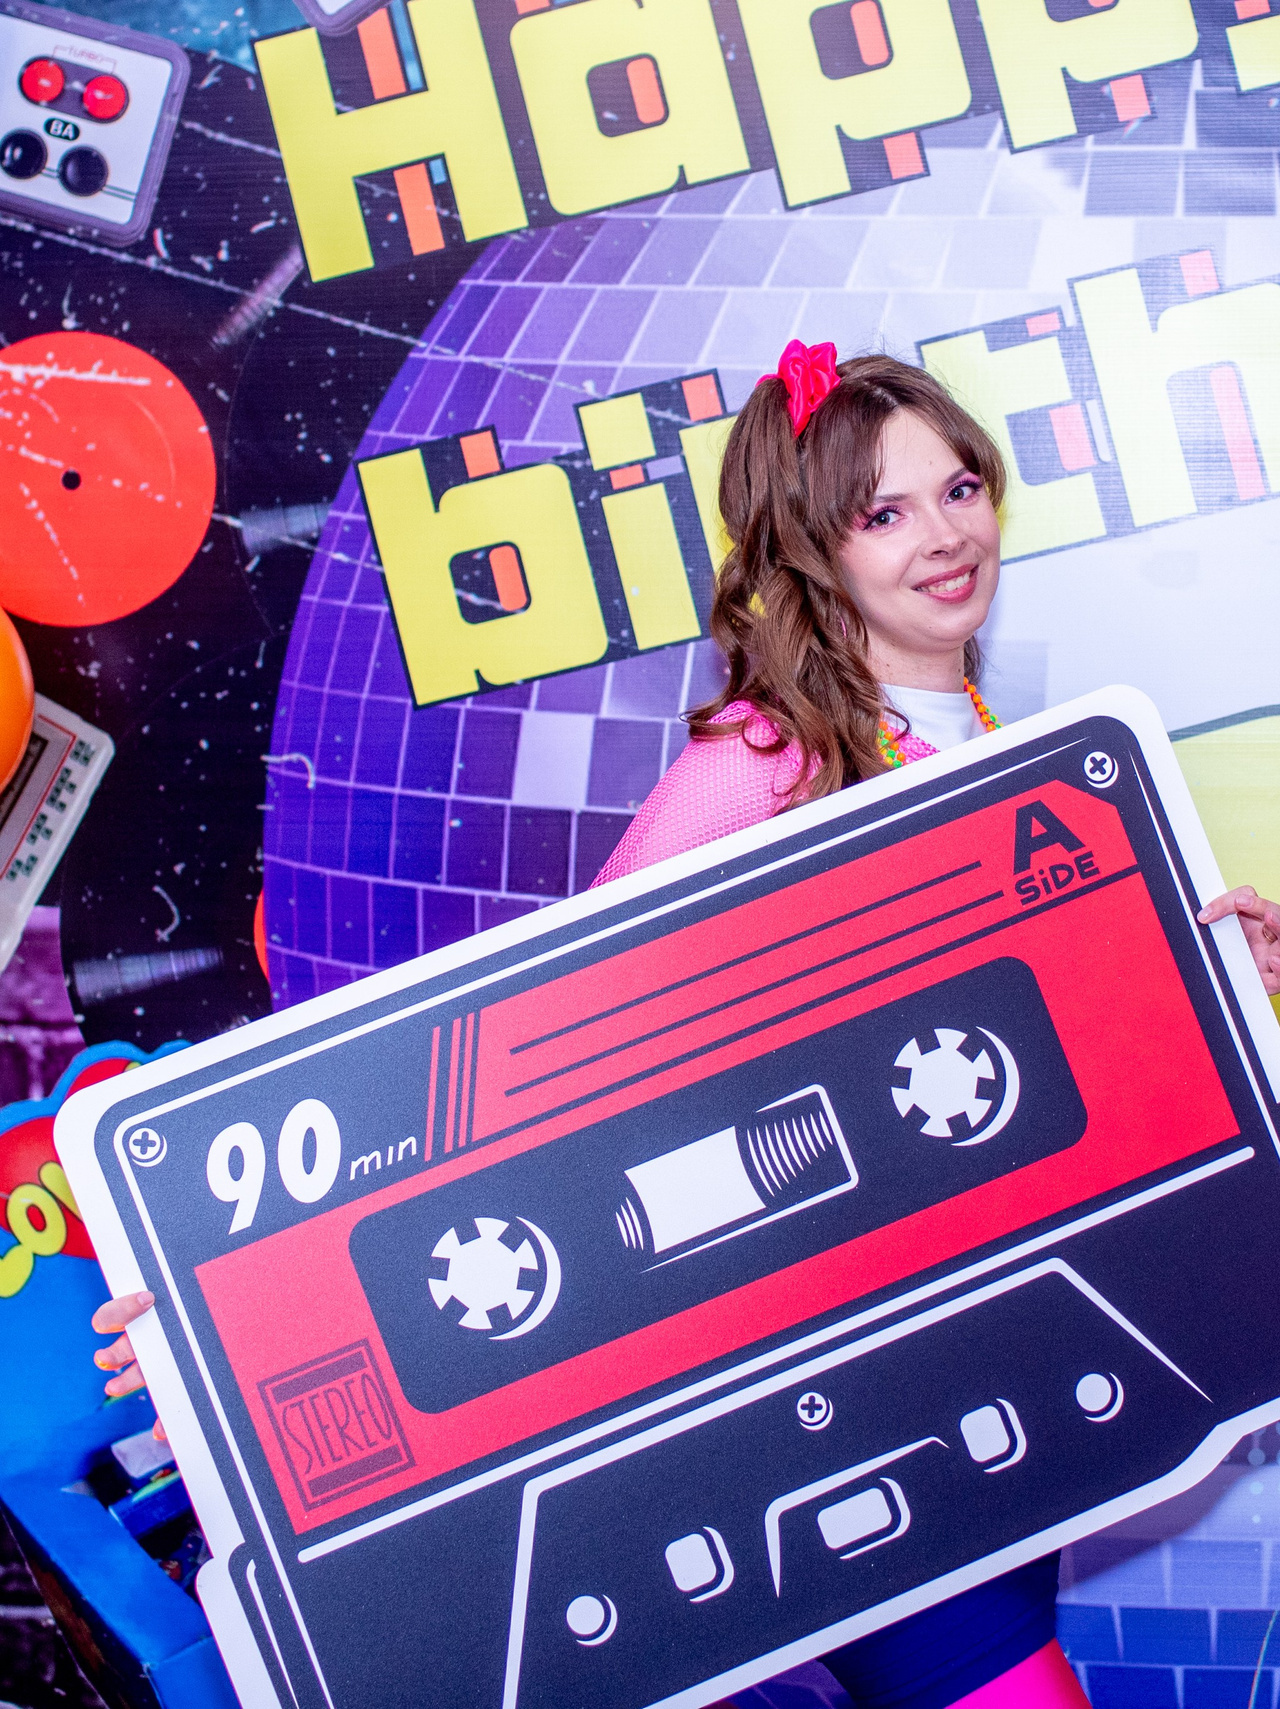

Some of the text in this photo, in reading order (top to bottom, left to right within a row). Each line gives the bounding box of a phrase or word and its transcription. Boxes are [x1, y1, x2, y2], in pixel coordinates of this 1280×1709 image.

[1013, 800, 1085, 875] A
[206, 1098, 417, 1235] 90 min
[280, 1370, 394, 1477] STEREO
